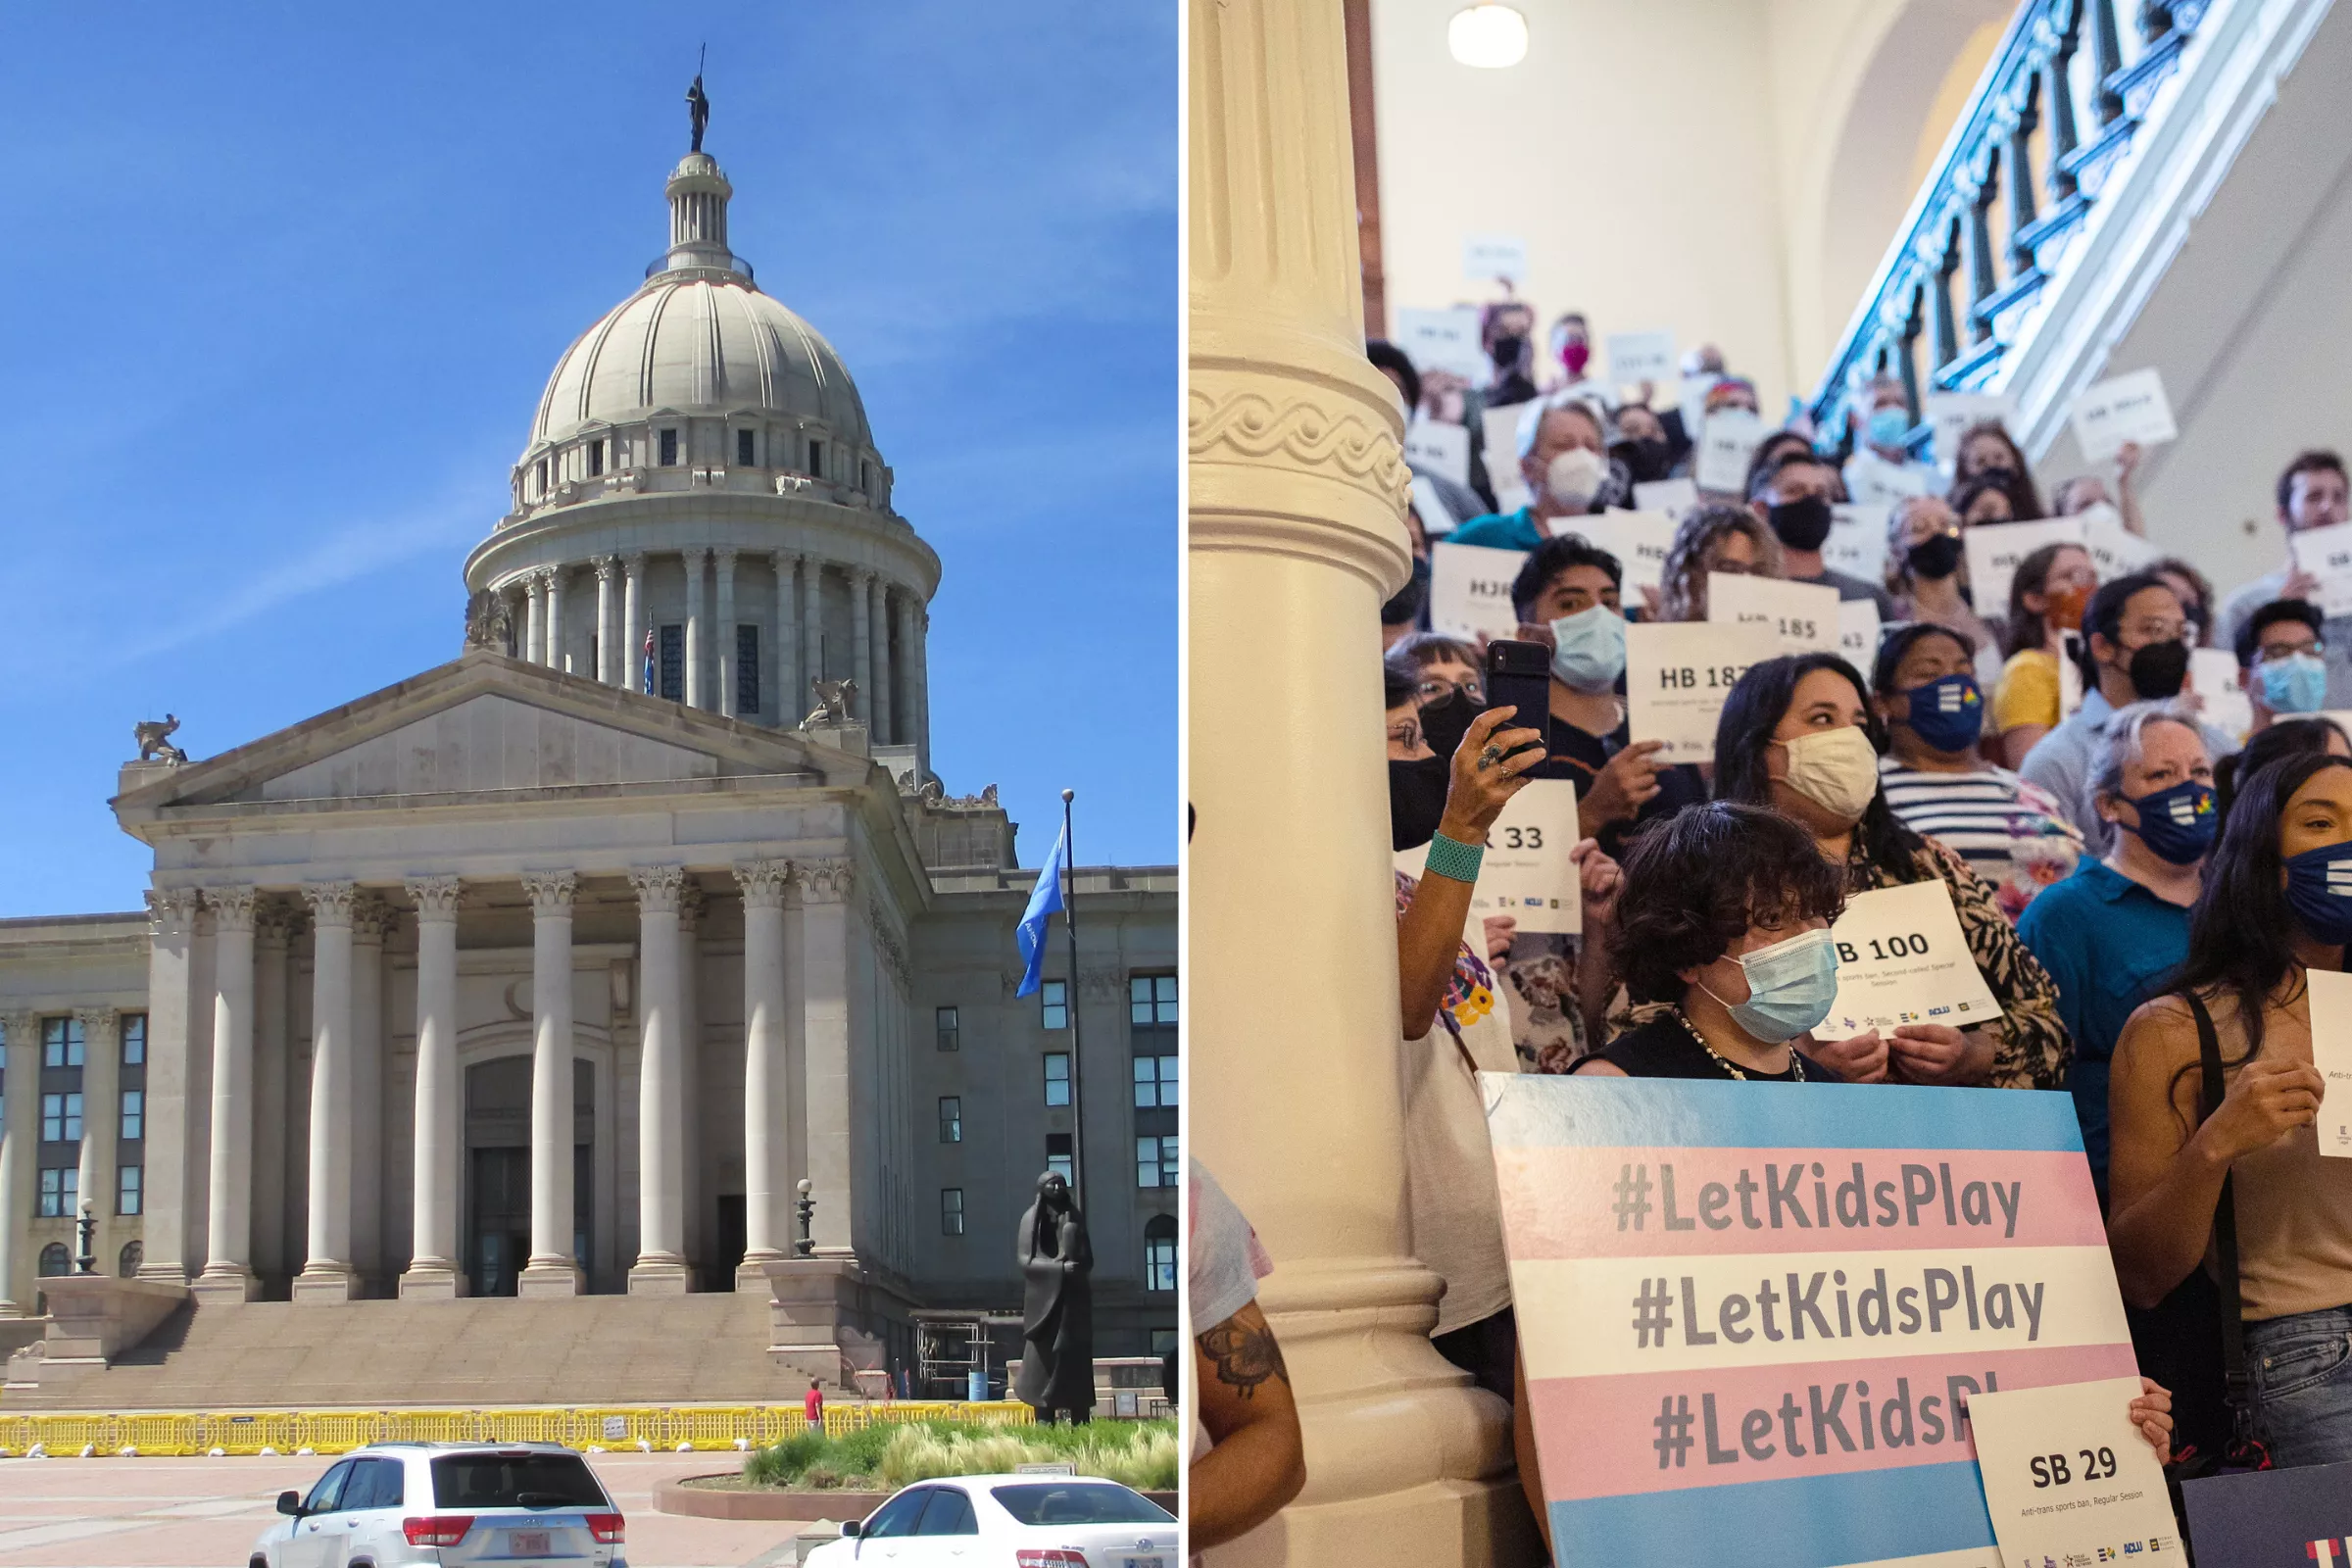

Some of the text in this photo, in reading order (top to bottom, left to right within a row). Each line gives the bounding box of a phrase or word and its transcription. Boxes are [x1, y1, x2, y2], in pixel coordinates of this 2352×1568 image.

[1779, 617, 1816, 640] 185
[1660, 666, 1696, 689] HB
[1505, 827, 1543, 849] 33
[1836, 933, 1930, 962] B 100
[2328, 1070, 2352, 1080] Anti-tr
[1612, 1161, 2022, 1239] #LetKidsPlay
[1632, 1265, 2045, 1348] #LetKidsPlay
[1652, 1371, 2000, 1471] #LetKidsP
[2030, 1446, 2118, 1489] SB 29
[2021, 1490, 2143, 1517] Anti-trans sports ban, Regular Session
[2124, 1542, 2143, 1554] ACLU
